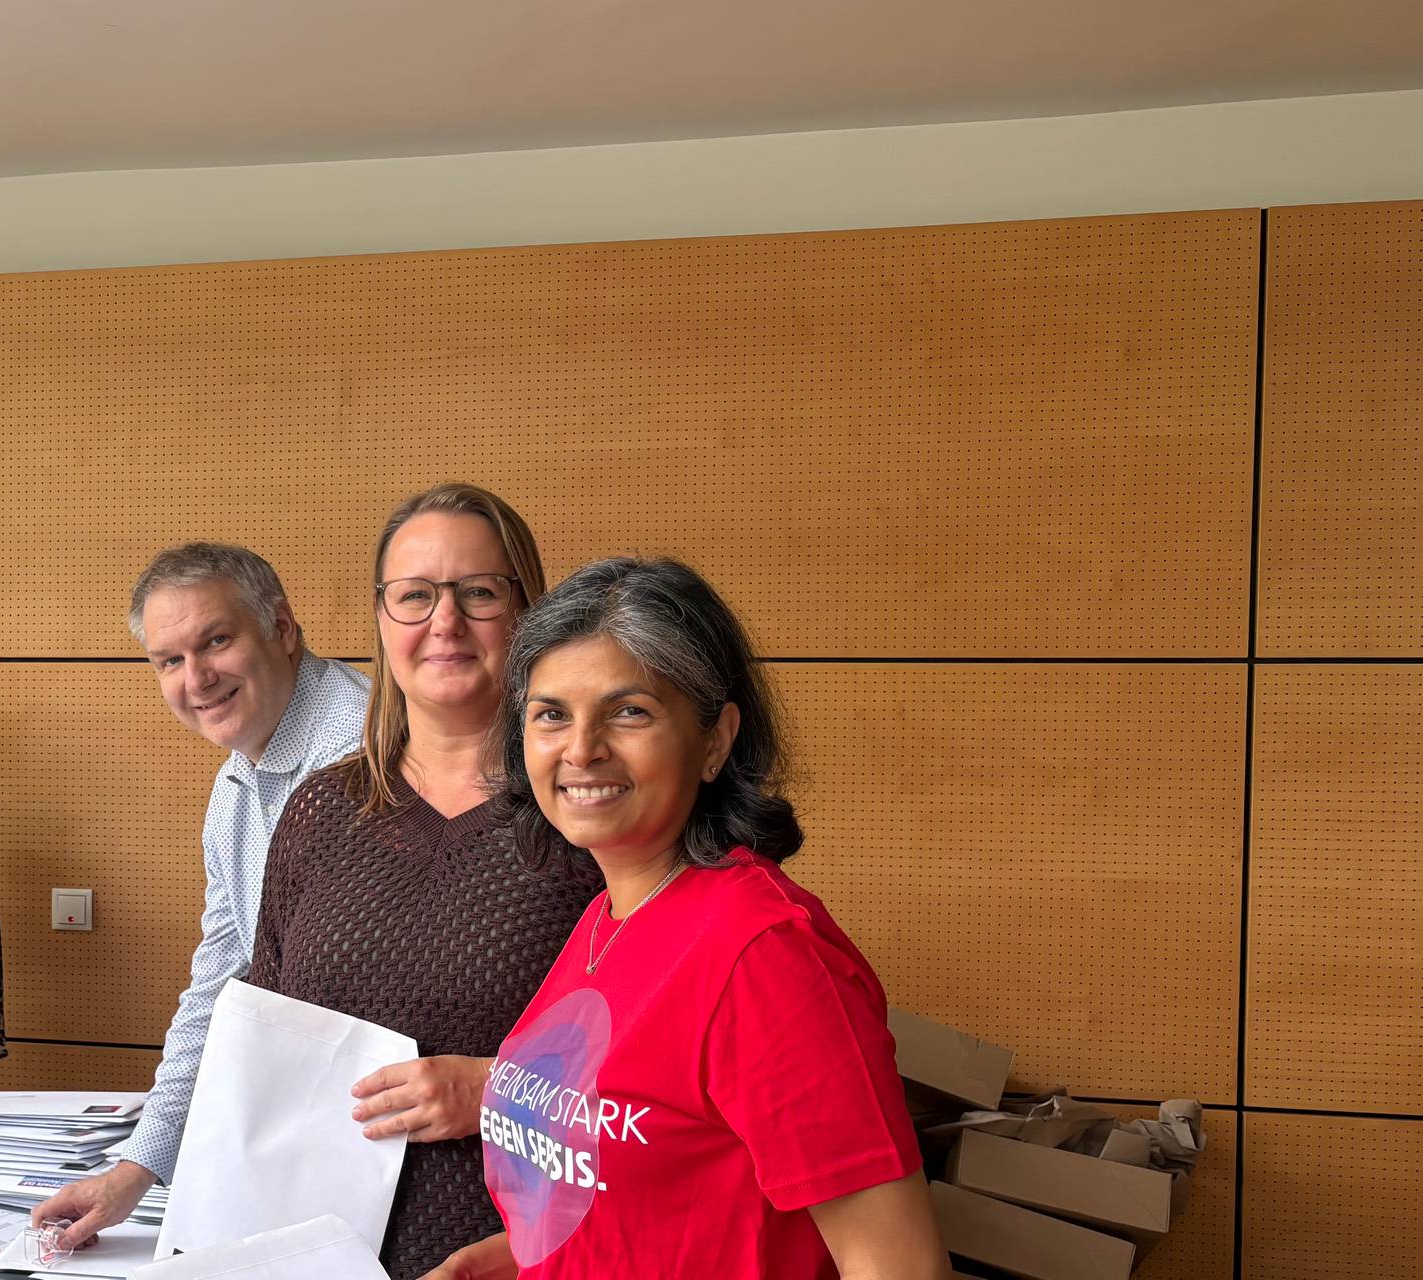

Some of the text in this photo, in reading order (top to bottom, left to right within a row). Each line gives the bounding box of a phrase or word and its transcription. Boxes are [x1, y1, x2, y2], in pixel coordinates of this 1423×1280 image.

[480, 1104, 528, 1159] EGEN
[485, 1056, 652, 1145] MEINSAM STARK
